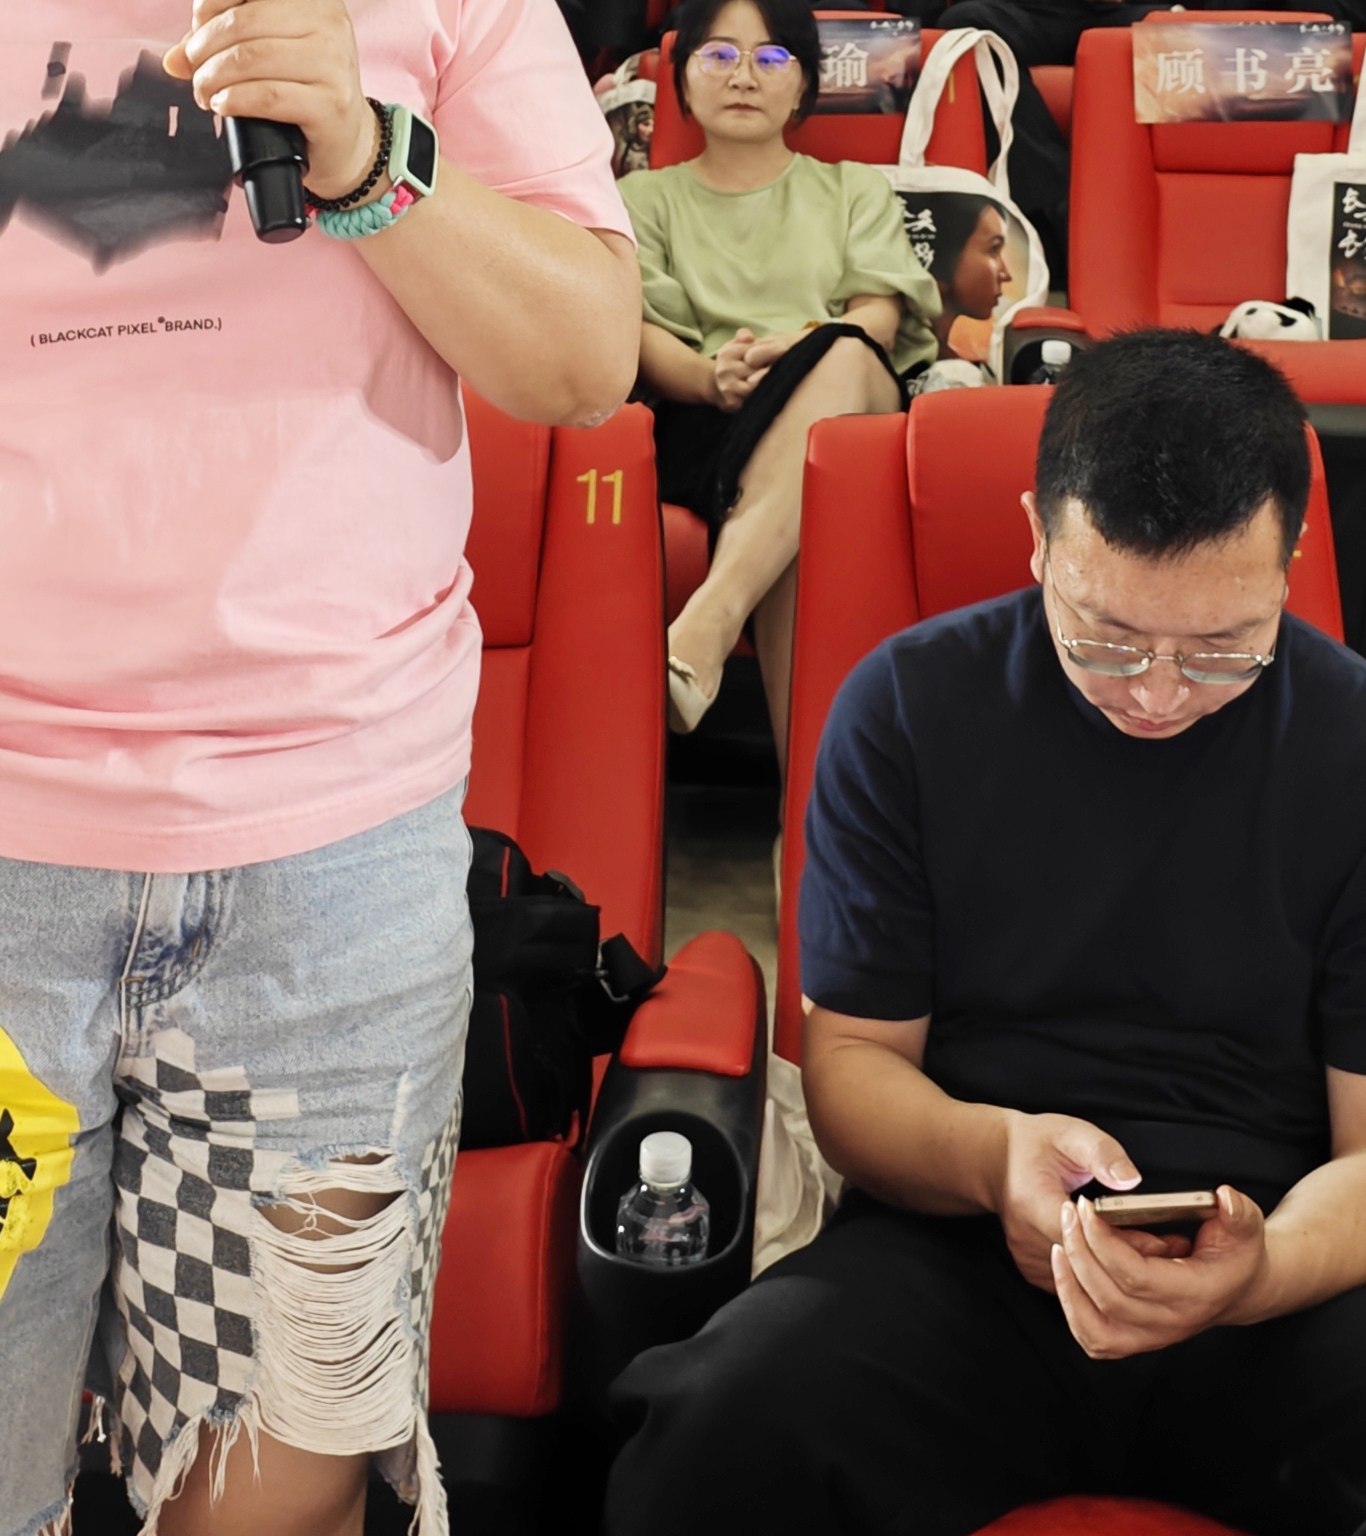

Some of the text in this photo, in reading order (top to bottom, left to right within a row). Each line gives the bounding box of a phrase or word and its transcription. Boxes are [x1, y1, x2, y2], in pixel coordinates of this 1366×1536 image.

[1156, 47, 1335, 95] 顾书亮
[576, 468, 623, 525] 11
